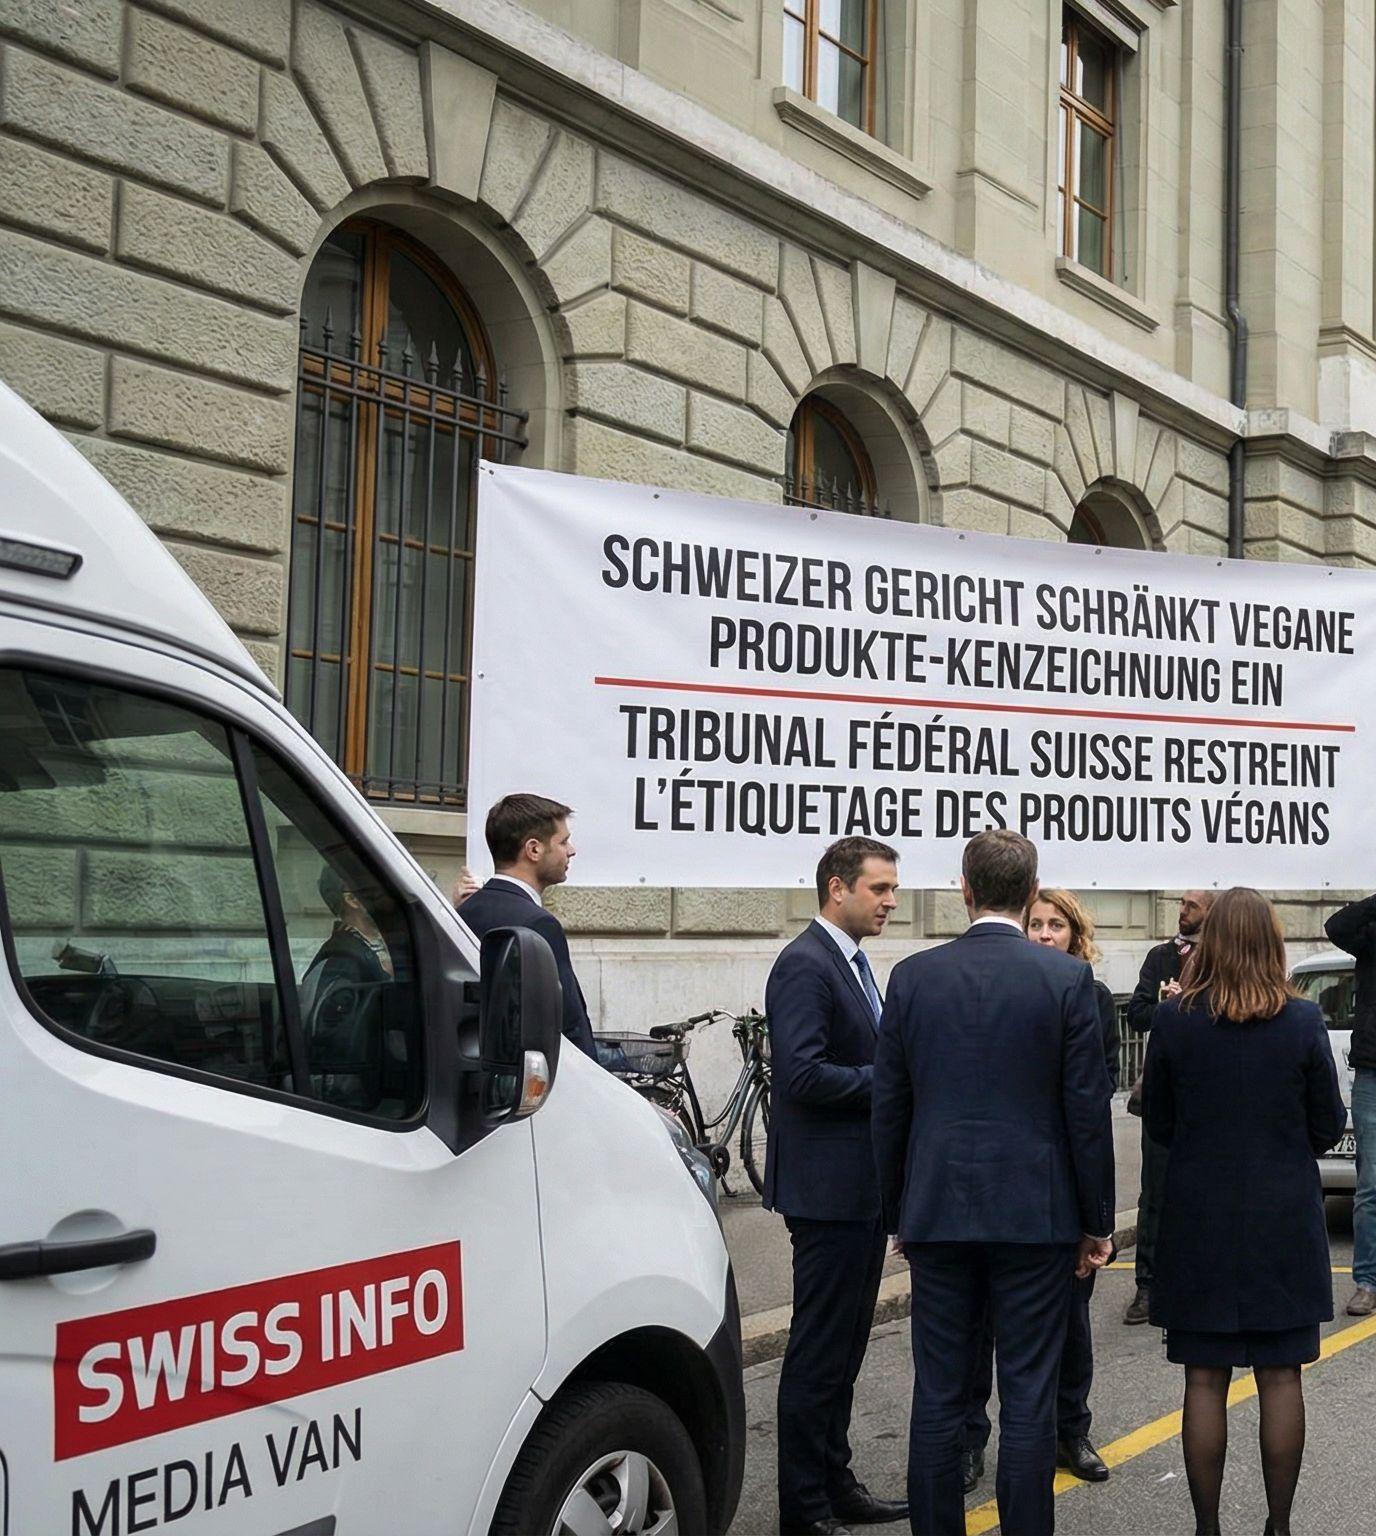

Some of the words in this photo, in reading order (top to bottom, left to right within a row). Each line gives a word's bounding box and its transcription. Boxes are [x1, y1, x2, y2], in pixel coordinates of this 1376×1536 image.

[601, 534, 852, 612] SCHWEIZER
[865, 564, 1025, 628] GERICHT
[1036, 576, 1220, 644] SCHRÄNKT
[1229, 602, 1355, 655] VEGANE
[710, 615, 1221, 703] PRODUKTE-KENZEICHNUNG
[1231, 660, 1283, 707] EIN
[619, 704, 836, 769] TRIBUNAL
[848, 711, 1020, 778] FÉDÉRAL
[1030, 730, 1153, 783] SUISSE
[1164, 737, 1341, 788] RESTREINT
[935, 789, 1007, 839] DES
[1020, 792, 1191, 844] PRODUITS
[1200, 790, 1330, 846] VÉGANS
[77, 1301, 303, 1424] SWISS
[320, 1268, 449, 1363] INFO
[71, 1442, 253, 1536] MEDIA
[265, 1407, 361, 1487] VAN
